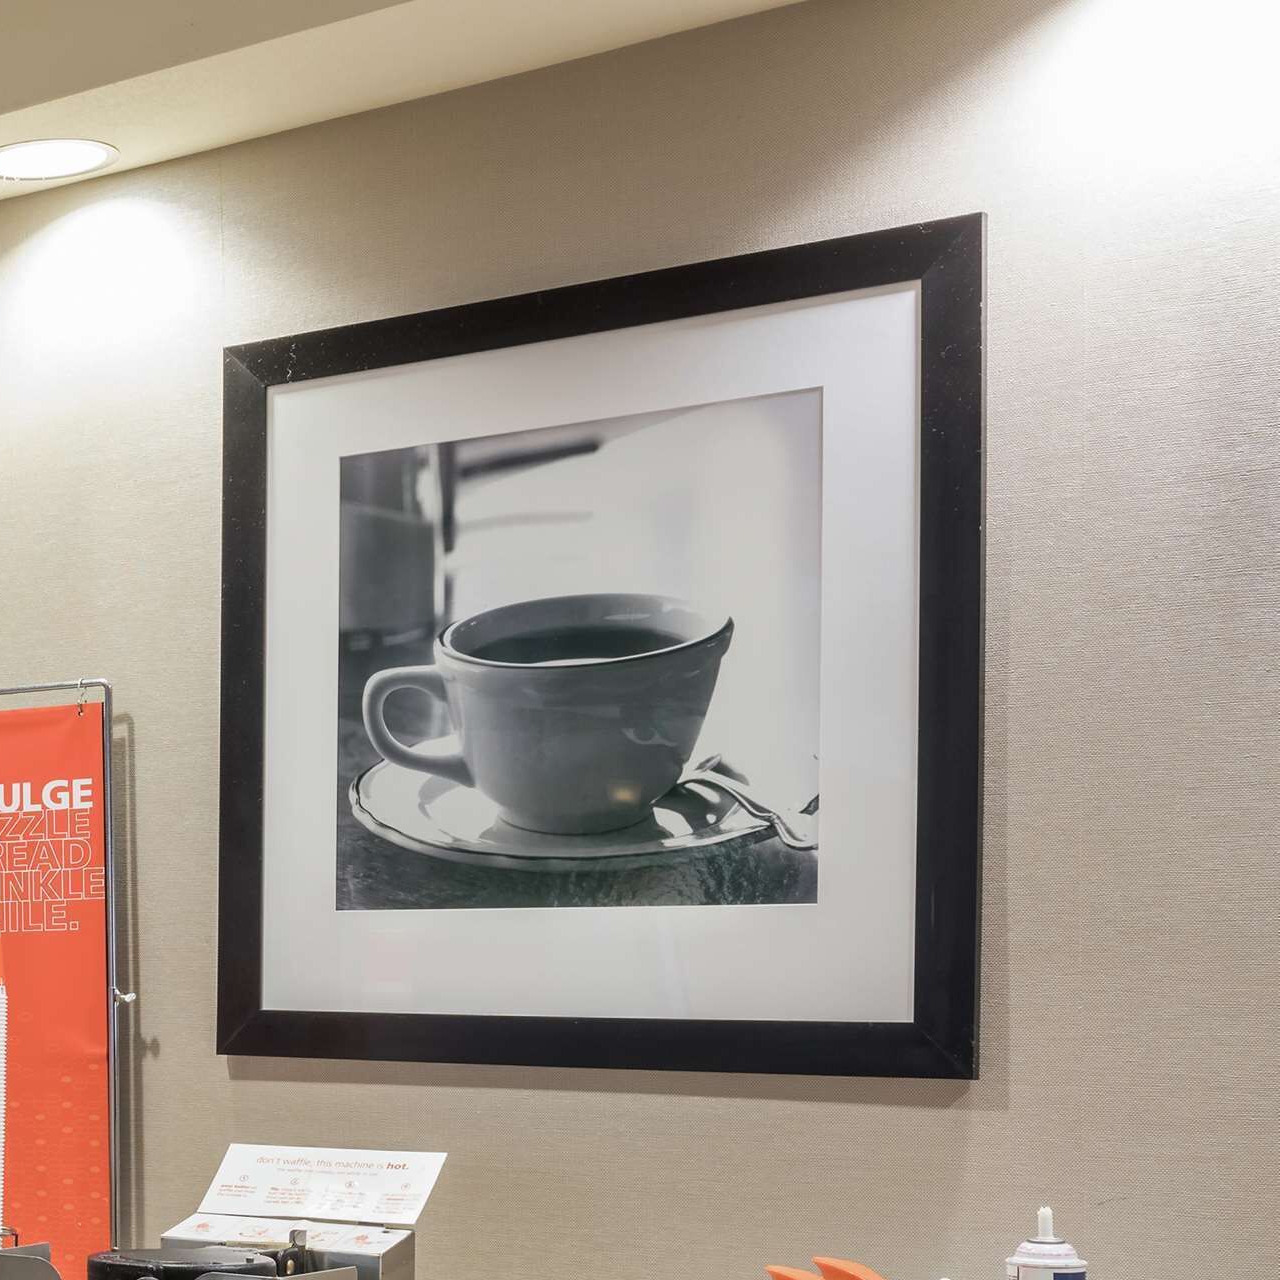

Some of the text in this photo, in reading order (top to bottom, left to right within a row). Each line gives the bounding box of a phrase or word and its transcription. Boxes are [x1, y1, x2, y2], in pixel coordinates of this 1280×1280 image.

[316, 1160, 332, 1168] this
[334, 1161, 374, 1169] machine
[386, 1162, 409, 1170] hot.
